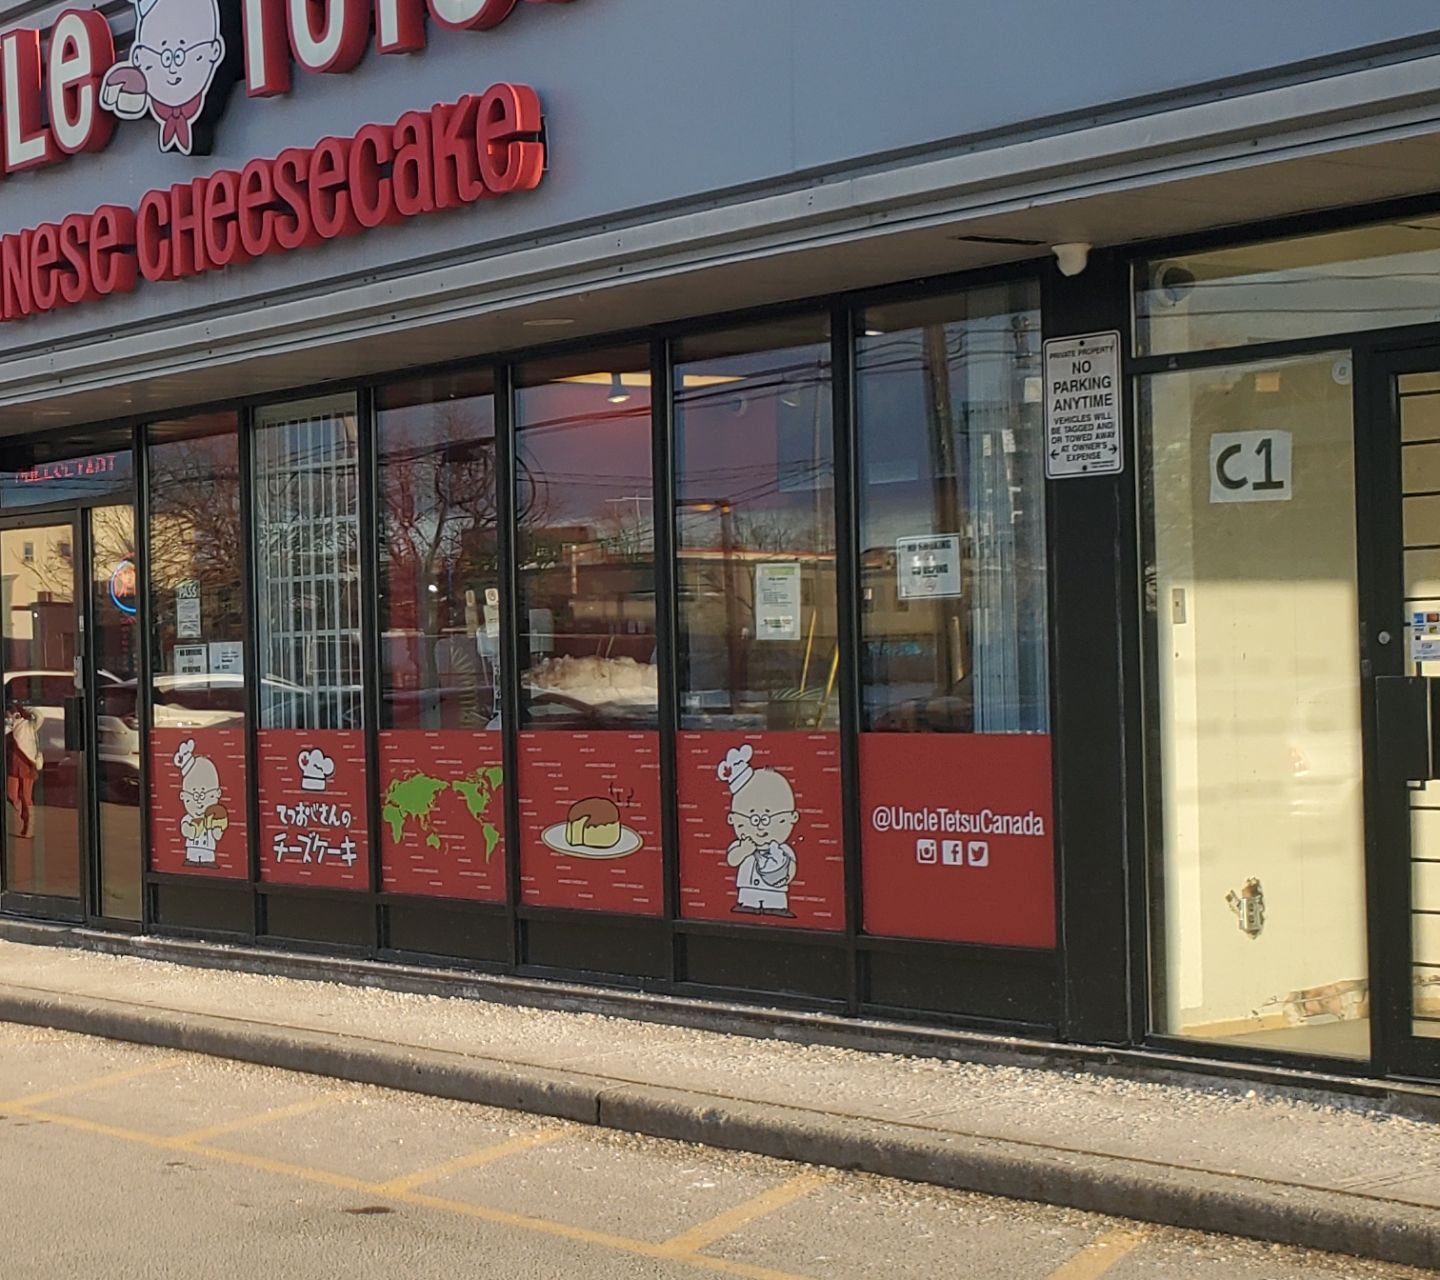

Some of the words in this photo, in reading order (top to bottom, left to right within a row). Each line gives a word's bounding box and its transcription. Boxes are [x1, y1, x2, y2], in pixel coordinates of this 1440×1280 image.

[1078, 345, 1114, 357] PROPERTY
[1072, 360, 1091, 374] NO
[1053, 376, 1111, 394] PARKING
[1053, 393, 1113, 412] ANYTIME
[1053, 413, 1092, 424] VEHICLES
[1093, 412, 1112, 420] WILL
[1051, 426, 1061, 435] BE
[1064, 423, 1094, 433] TAGGED
[1097, 421, 1114, 430] AND
[1051, 435, 1062, 444] OR
[1065, 433, 1092, 443] TOWED
[1095, 431, 1115, 440] AWAY
[1061, 444, 1070, 453] AT
[1072, 442, 1107, 452] OWNER'S
[1066, 451, 1101, 462] EXPENSE
[1216, 438, 1284, 491] C1
[179, 585, 197, 598] PASS
[276, 801, 352, 828] てつおじさんの
[872, 805, 1045, 836] @UncleTetsuCanada
[273, 832, 357, 867] チーズケーキ
